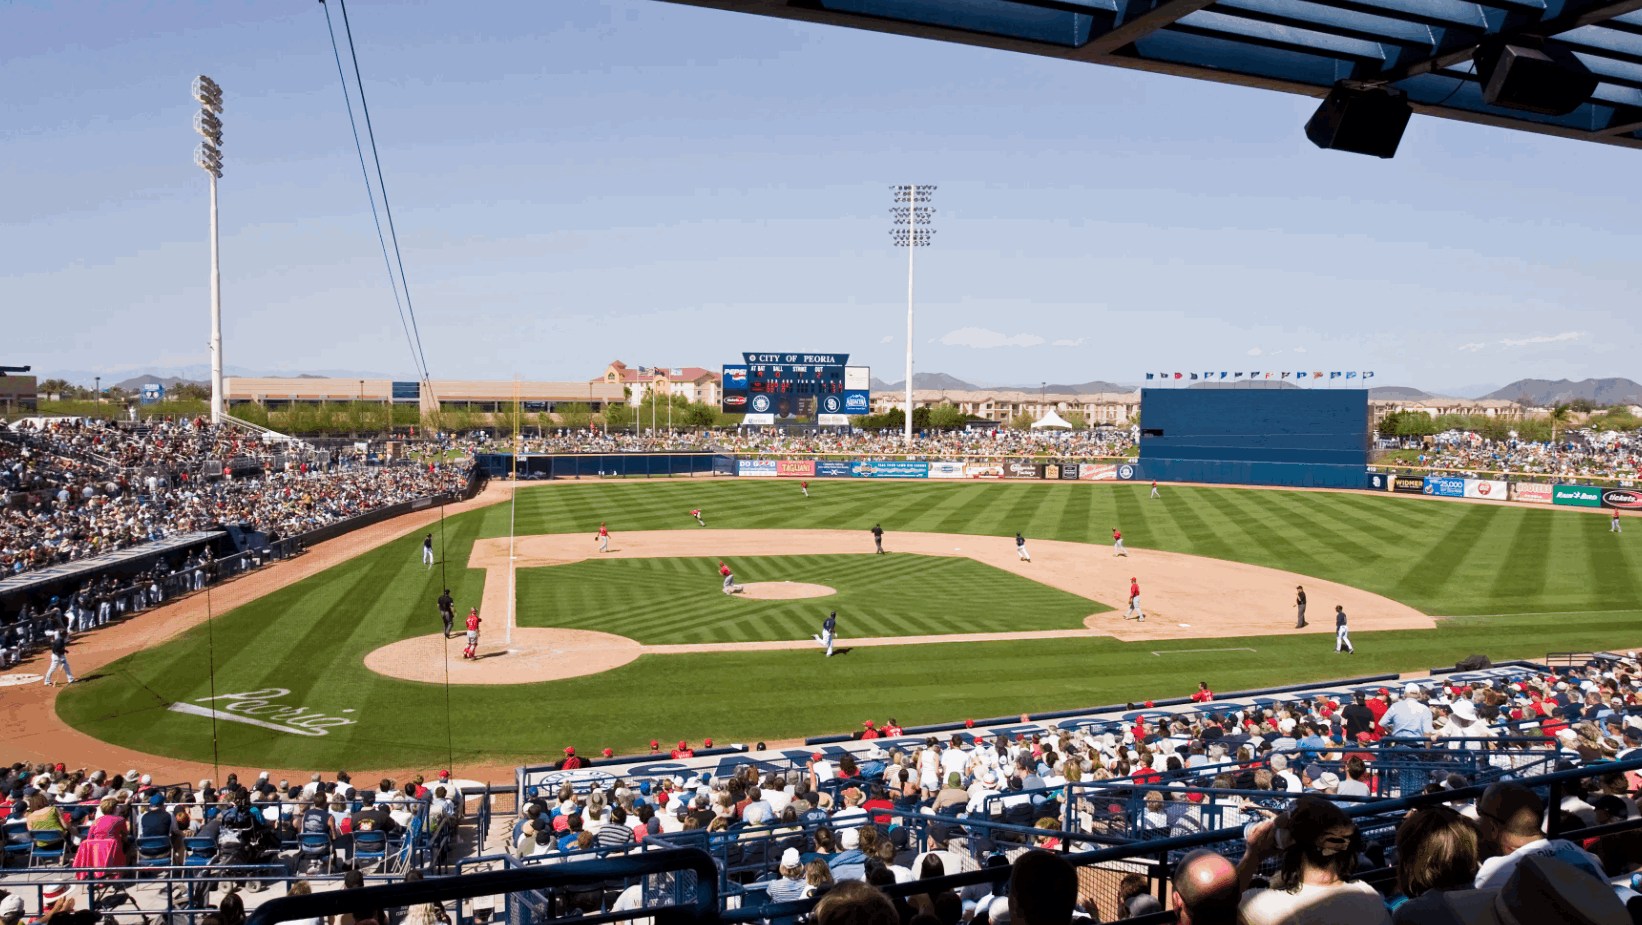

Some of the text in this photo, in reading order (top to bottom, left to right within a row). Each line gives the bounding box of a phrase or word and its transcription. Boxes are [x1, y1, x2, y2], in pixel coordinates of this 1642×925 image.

[759, 354, 836, 363] CITY OF PEORIA
[1395, 480, 1423, 488] WIDMER
[1515, 483, 1552, 494] HOOTERS
